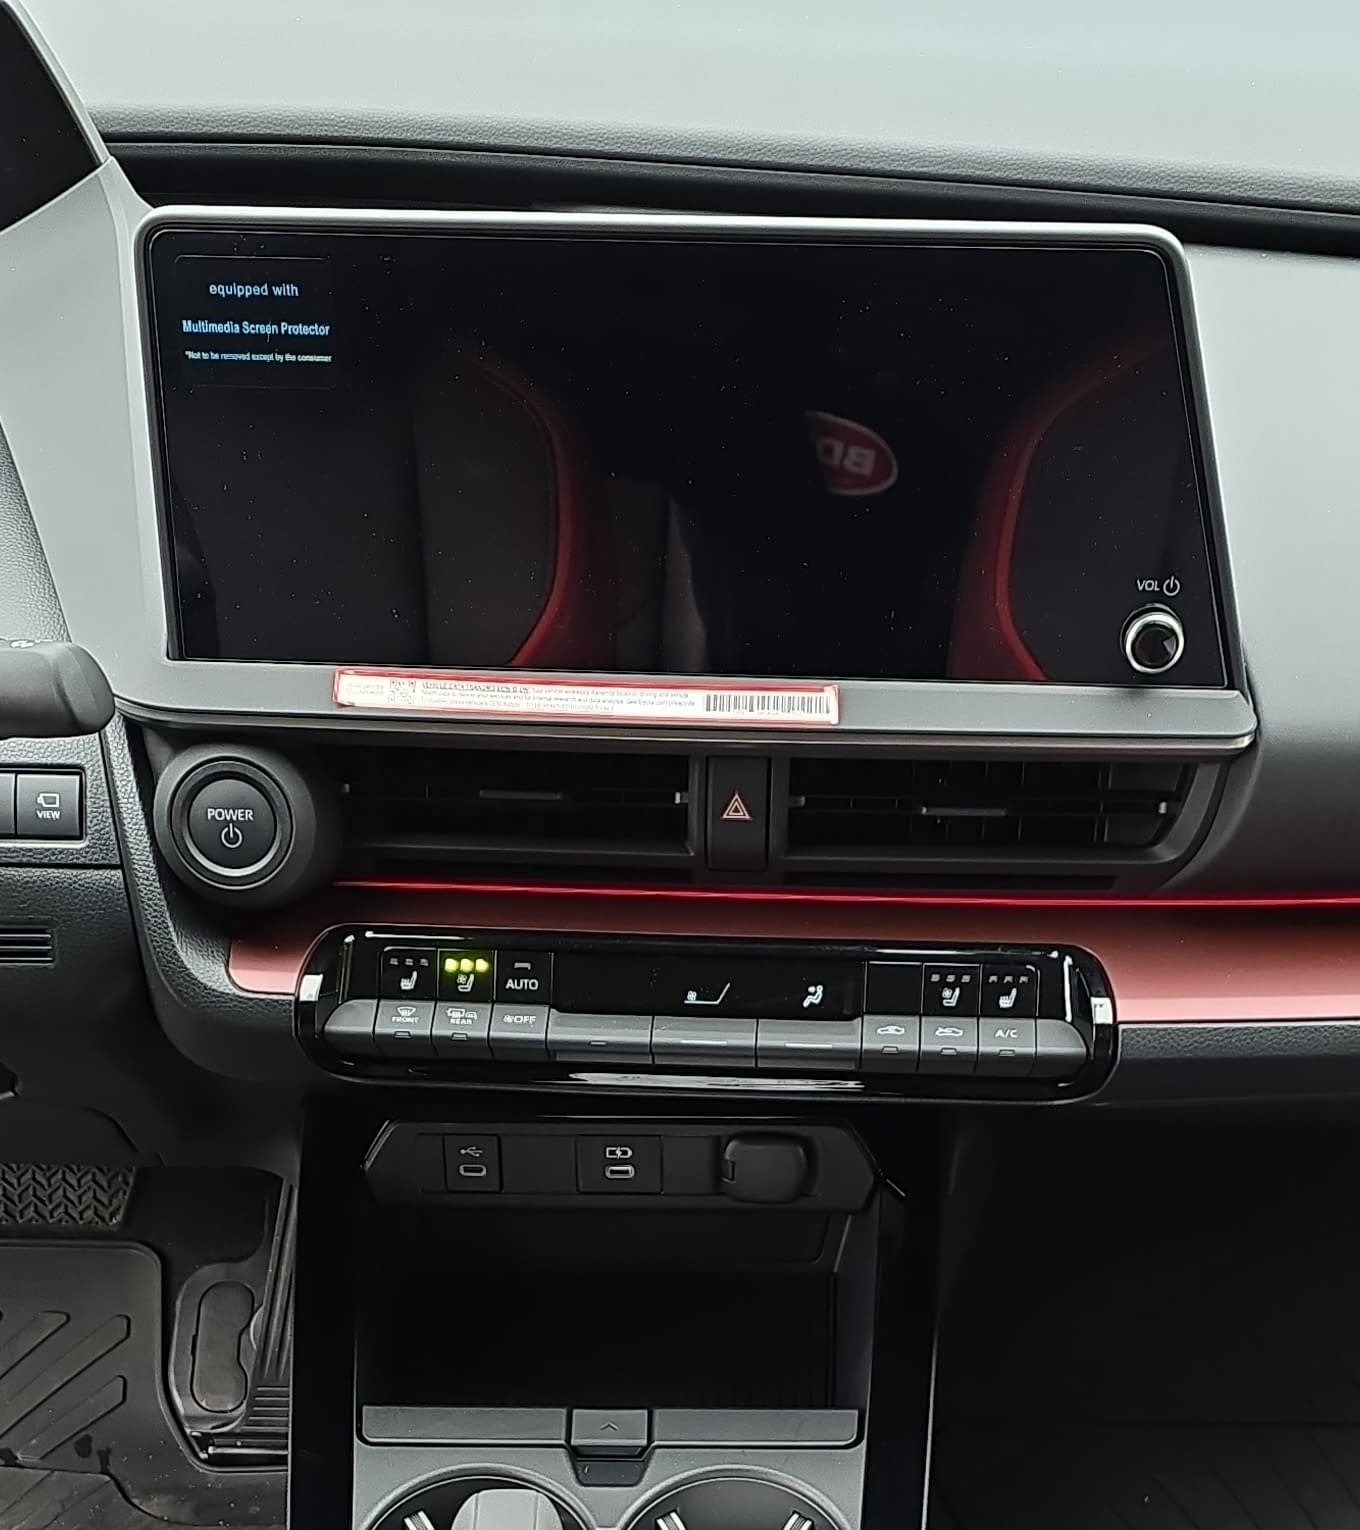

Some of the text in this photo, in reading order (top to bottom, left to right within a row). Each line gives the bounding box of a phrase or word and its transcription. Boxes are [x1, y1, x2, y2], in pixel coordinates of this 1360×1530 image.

[209, 283, 299, 297] equipped with
[182, 319, 330, 336] Multimedia Screen Protector
[1136, 579, 1160, 592] VOL
[36, 810, 60, 820] VIEW
[206, 808, 254, 821] POWER
[505, 979, 539, 990] AUTO
[391, 1015, 420, 1024] FRONT
[513, 1015, 537, 1024] OFF
[995, 1028, 1017, 1038] A/C
